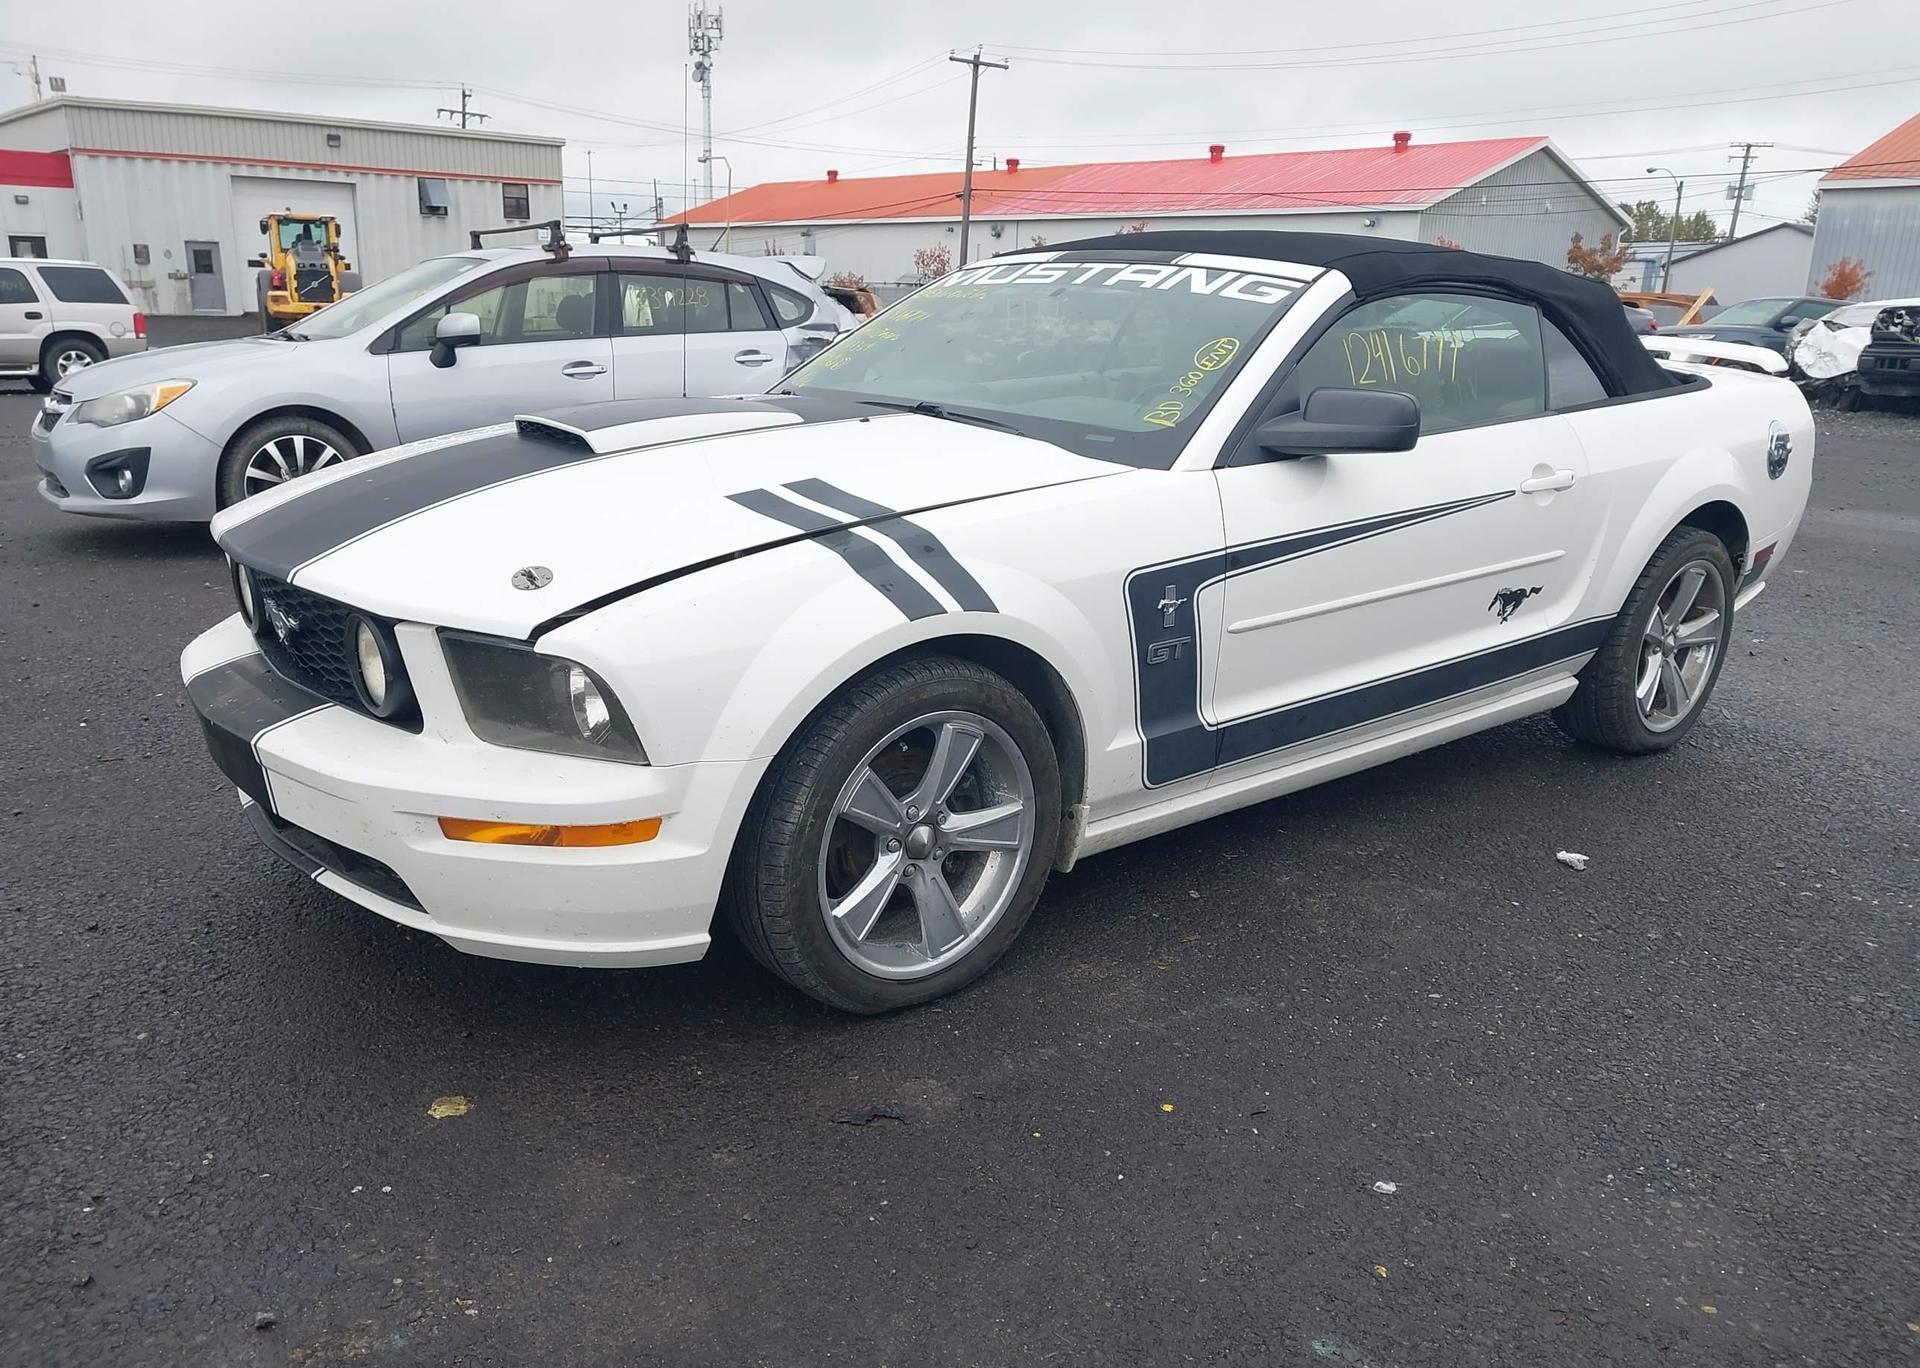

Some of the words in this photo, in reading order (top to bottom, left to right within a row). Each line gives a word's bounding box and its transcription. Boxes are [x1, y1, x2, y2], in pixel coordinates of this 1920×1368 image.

[943, 262, 1306, 304] MUSTANG
[1143, 401, 1184, 428] BD
[1170, 371, 1204, 397] 360
[1146, 635, 1192, 665] GT
